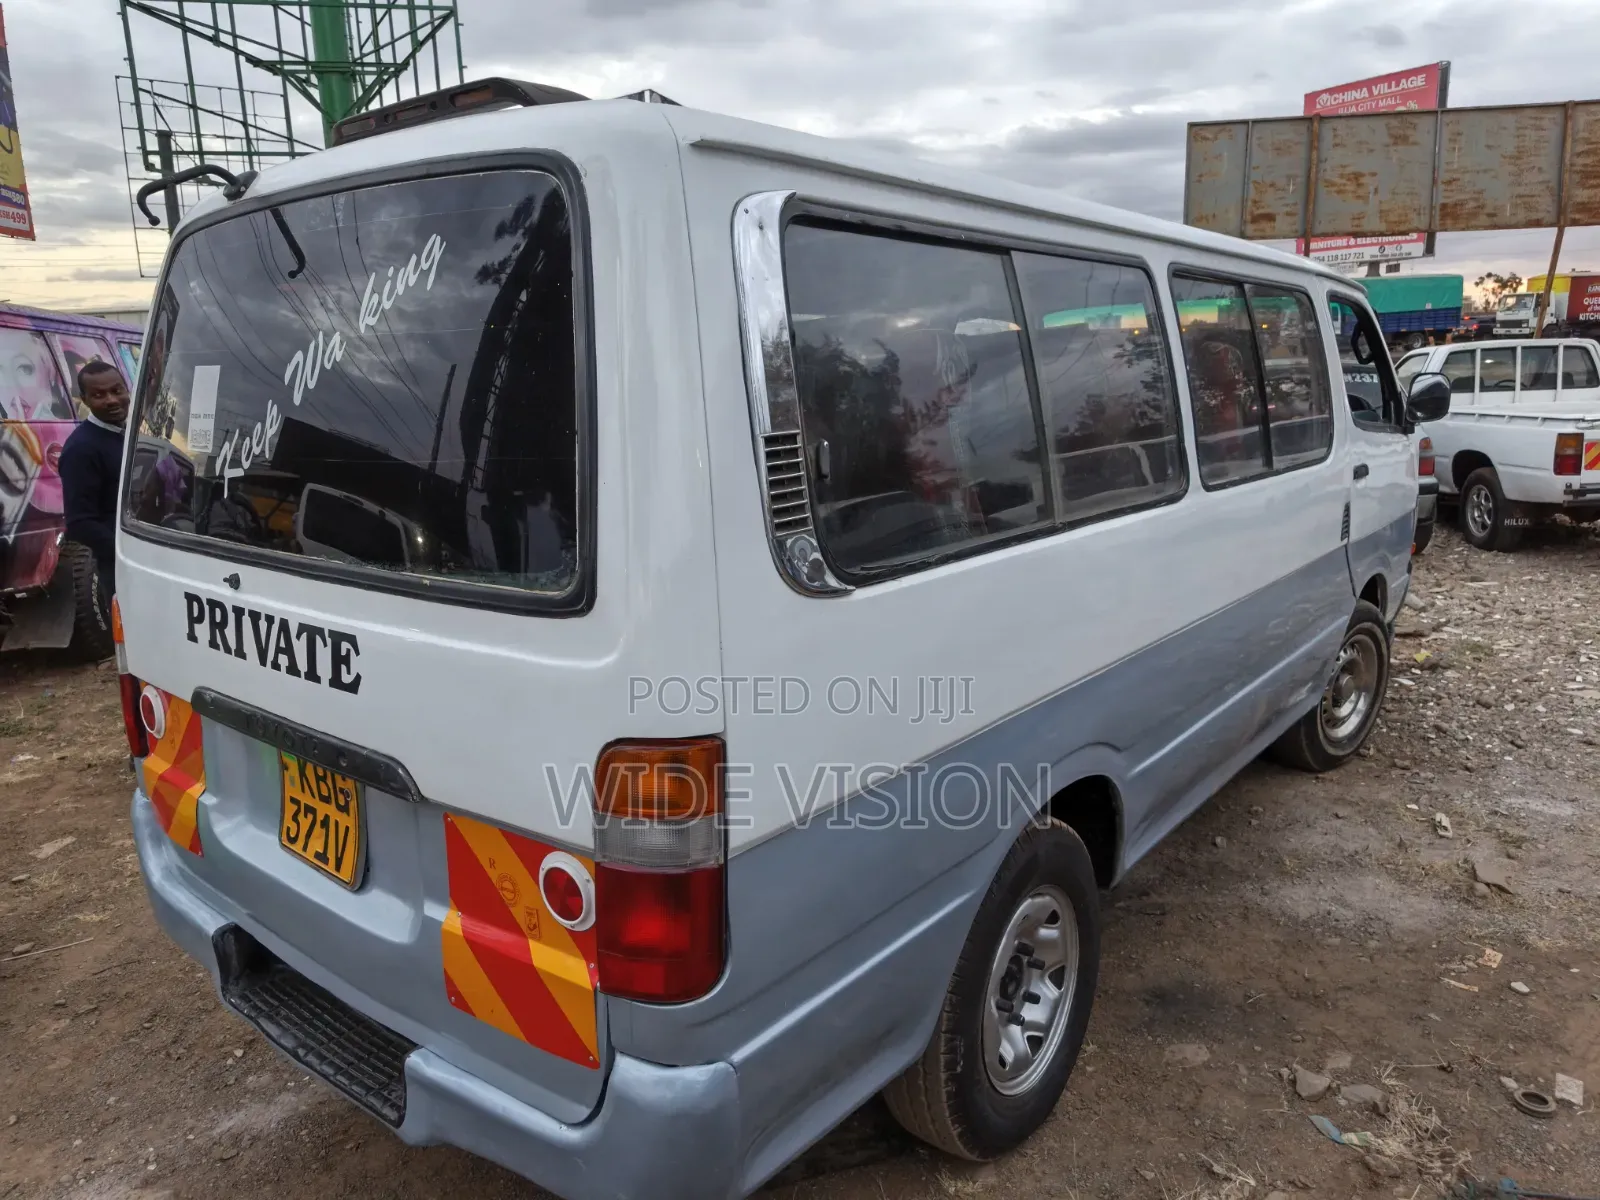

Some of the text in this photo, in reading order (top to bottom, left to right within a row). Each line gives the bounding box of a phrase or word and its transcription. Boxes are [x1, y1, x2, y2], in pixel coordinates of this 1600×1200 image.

[1331, 74, 1427, 105] CHINA VILLAGE
[1357, 100, 1377, 112] CITY
[1378, 96, 1402, 108] MALL
[1302, 239, 1348, 251] RNITURE
[1327, 254, 1339, 262] 118
[215, 233, 447, 499] Keep Wa king
[1504, 518, 1529, 526] HILUX
[183, 591, 363, 695] PRIVATE
[297, 757, 352, 817] KBG
[285, 795, 351, 874] 371V
[488, 857, 496, 869] R
